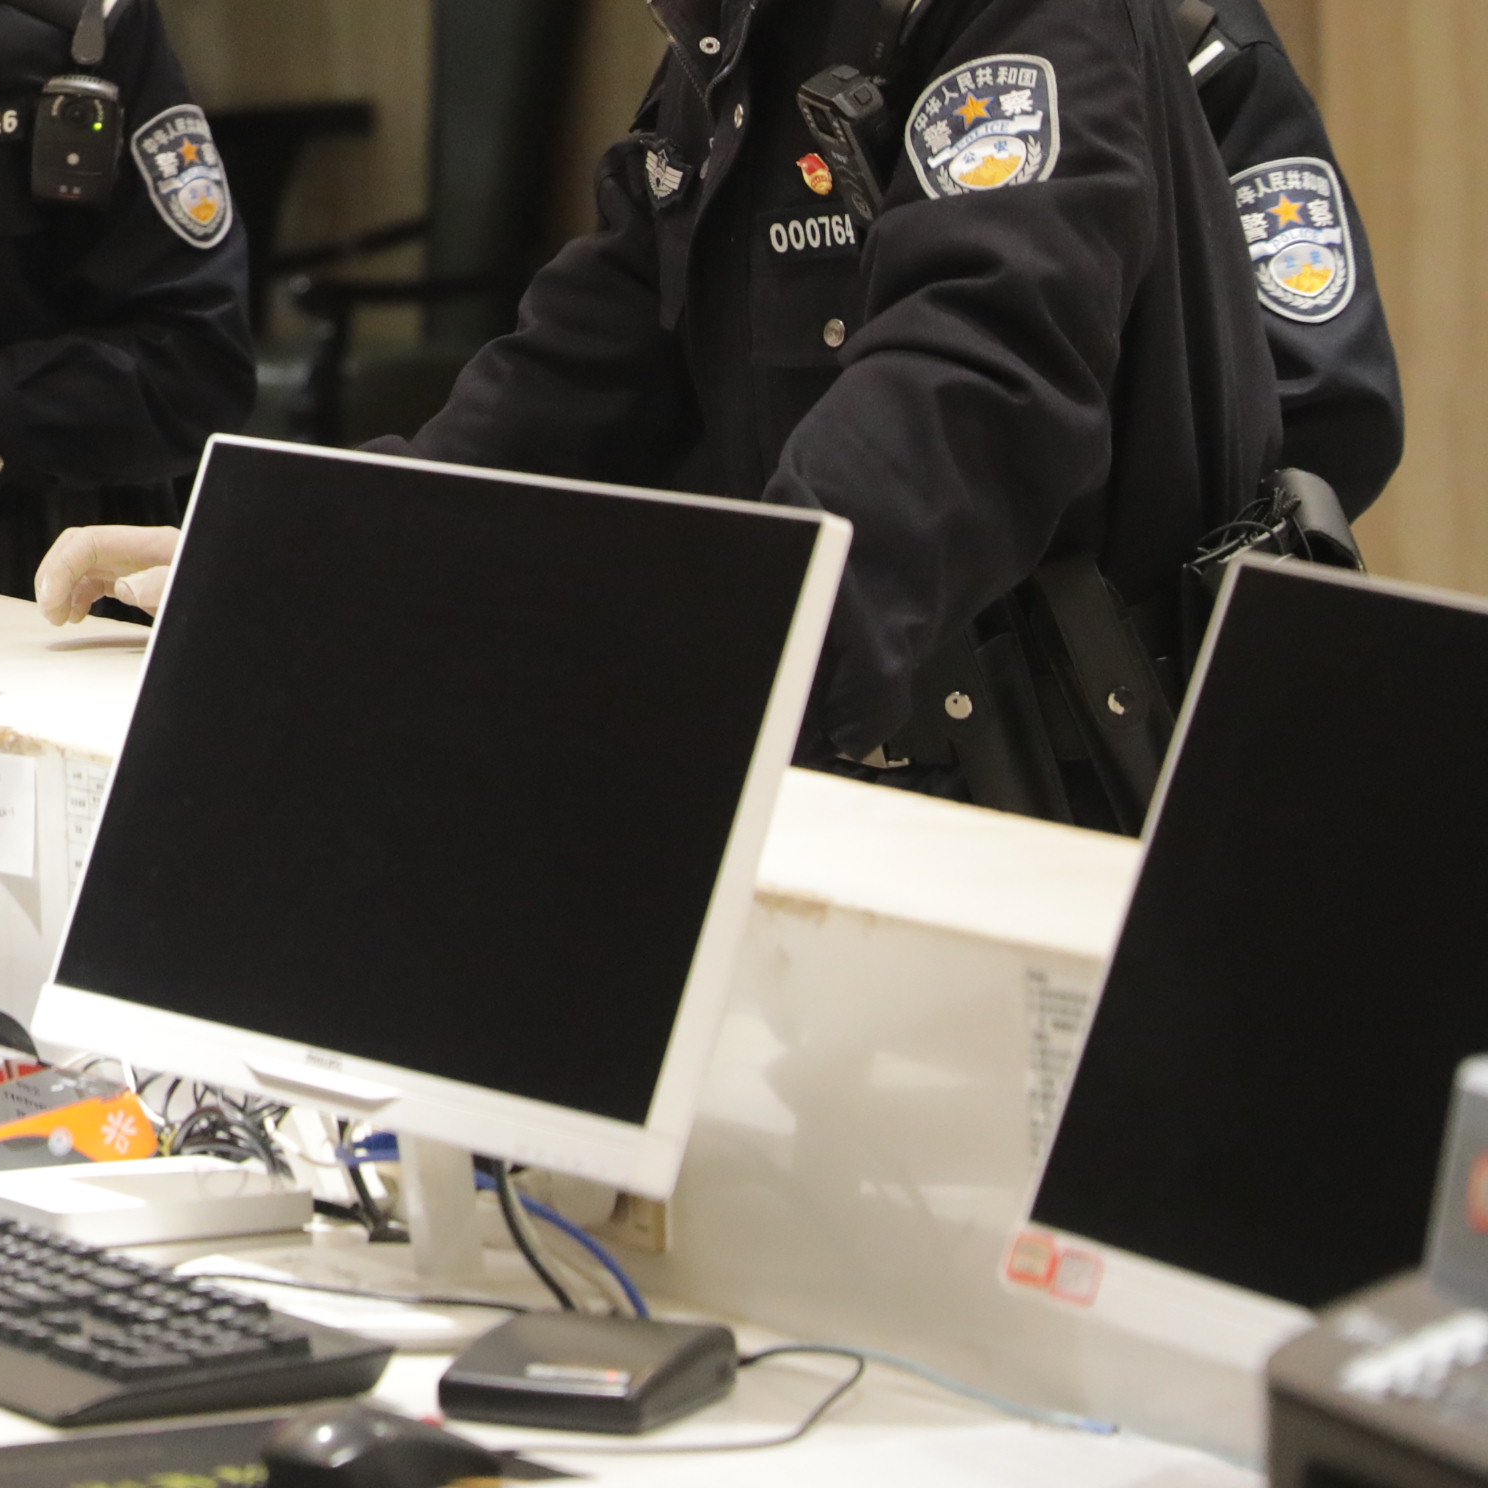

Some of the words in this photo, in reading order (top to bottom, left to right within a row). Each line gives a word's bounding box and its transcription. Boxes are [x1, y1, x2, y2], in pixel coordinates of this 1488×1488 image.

[913, 66, 1038, 132] 中华人民共和国
[999, 88, 1034, 117] 察
[955, 120, 1010, 154] POLICE
[1235, 169, 1331, 209] 华人民共和国
[769, 213, 856, 253] 000764
